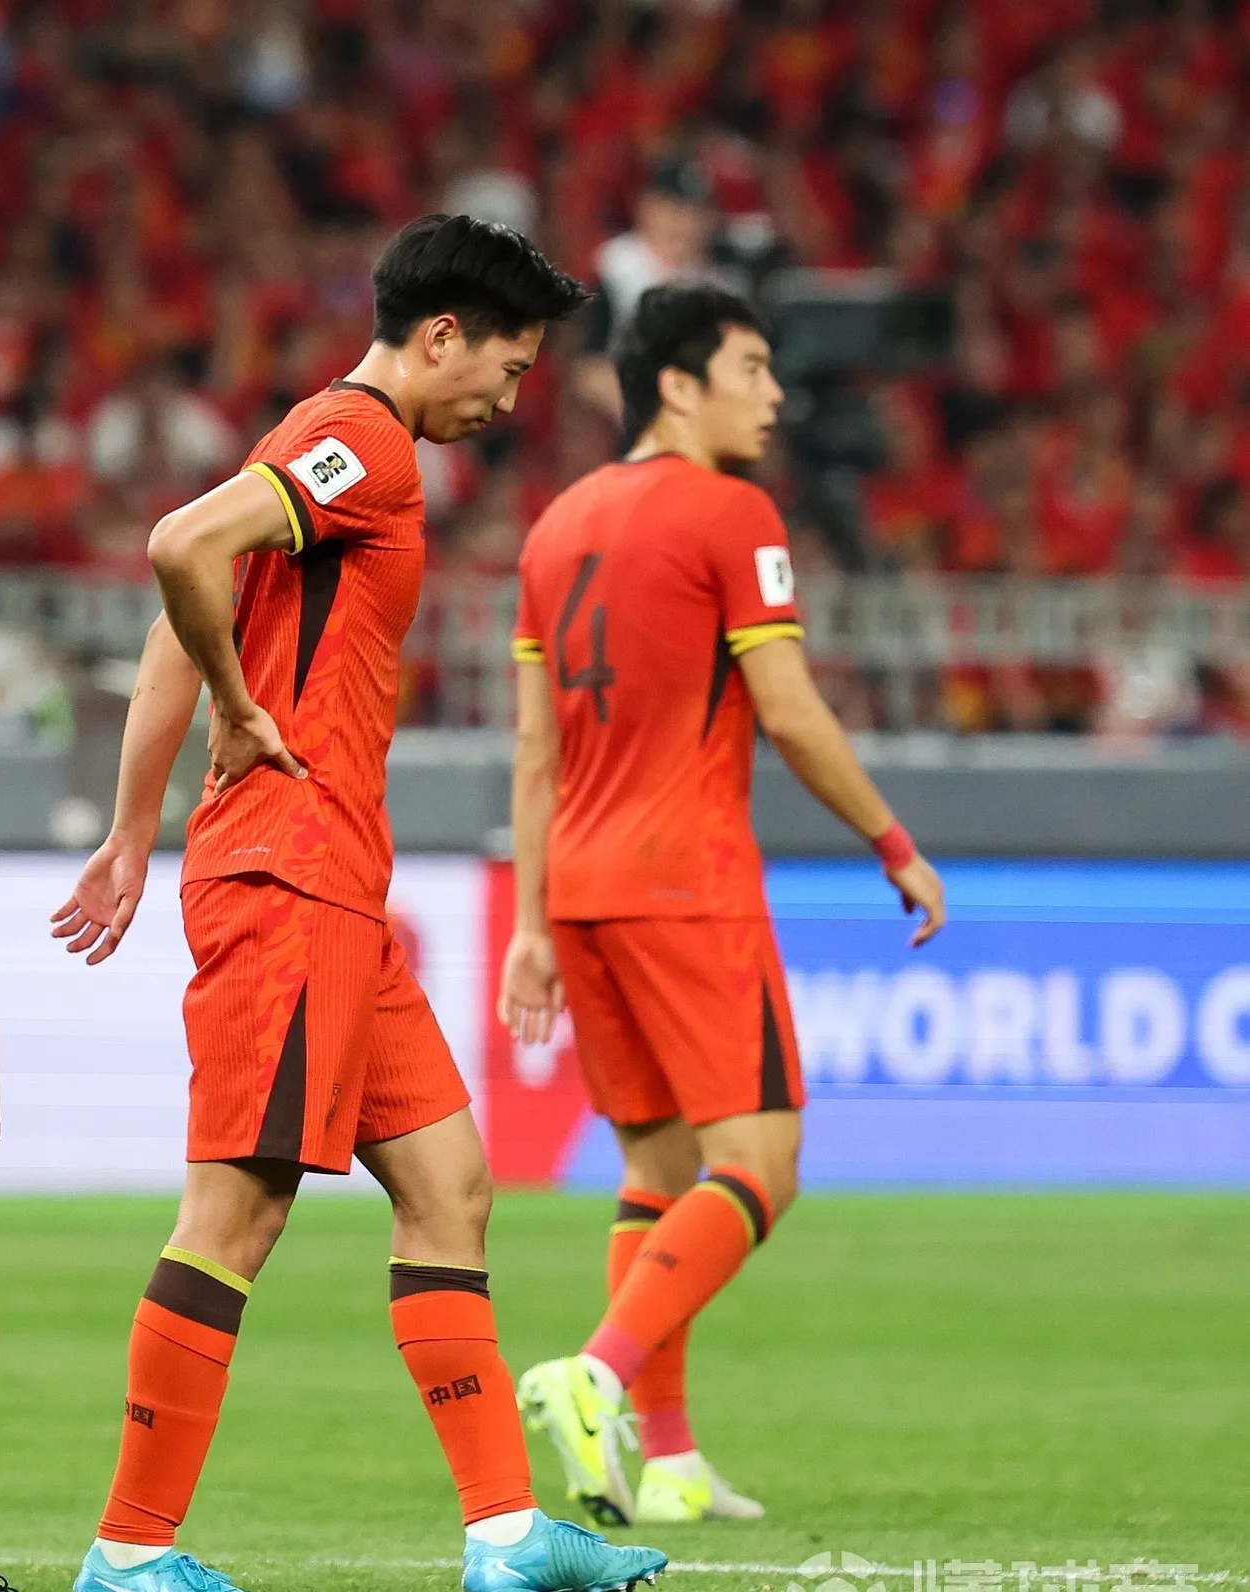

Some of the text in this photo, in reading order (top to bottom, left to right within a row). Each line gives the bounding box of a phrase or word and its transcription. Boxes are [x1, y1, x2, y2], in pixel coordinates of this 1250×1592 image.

[555, 553, 617, 725] 4
[786, 965, 1187, 1085] WORLD
[428, 1373, 482, 1405] 中国
